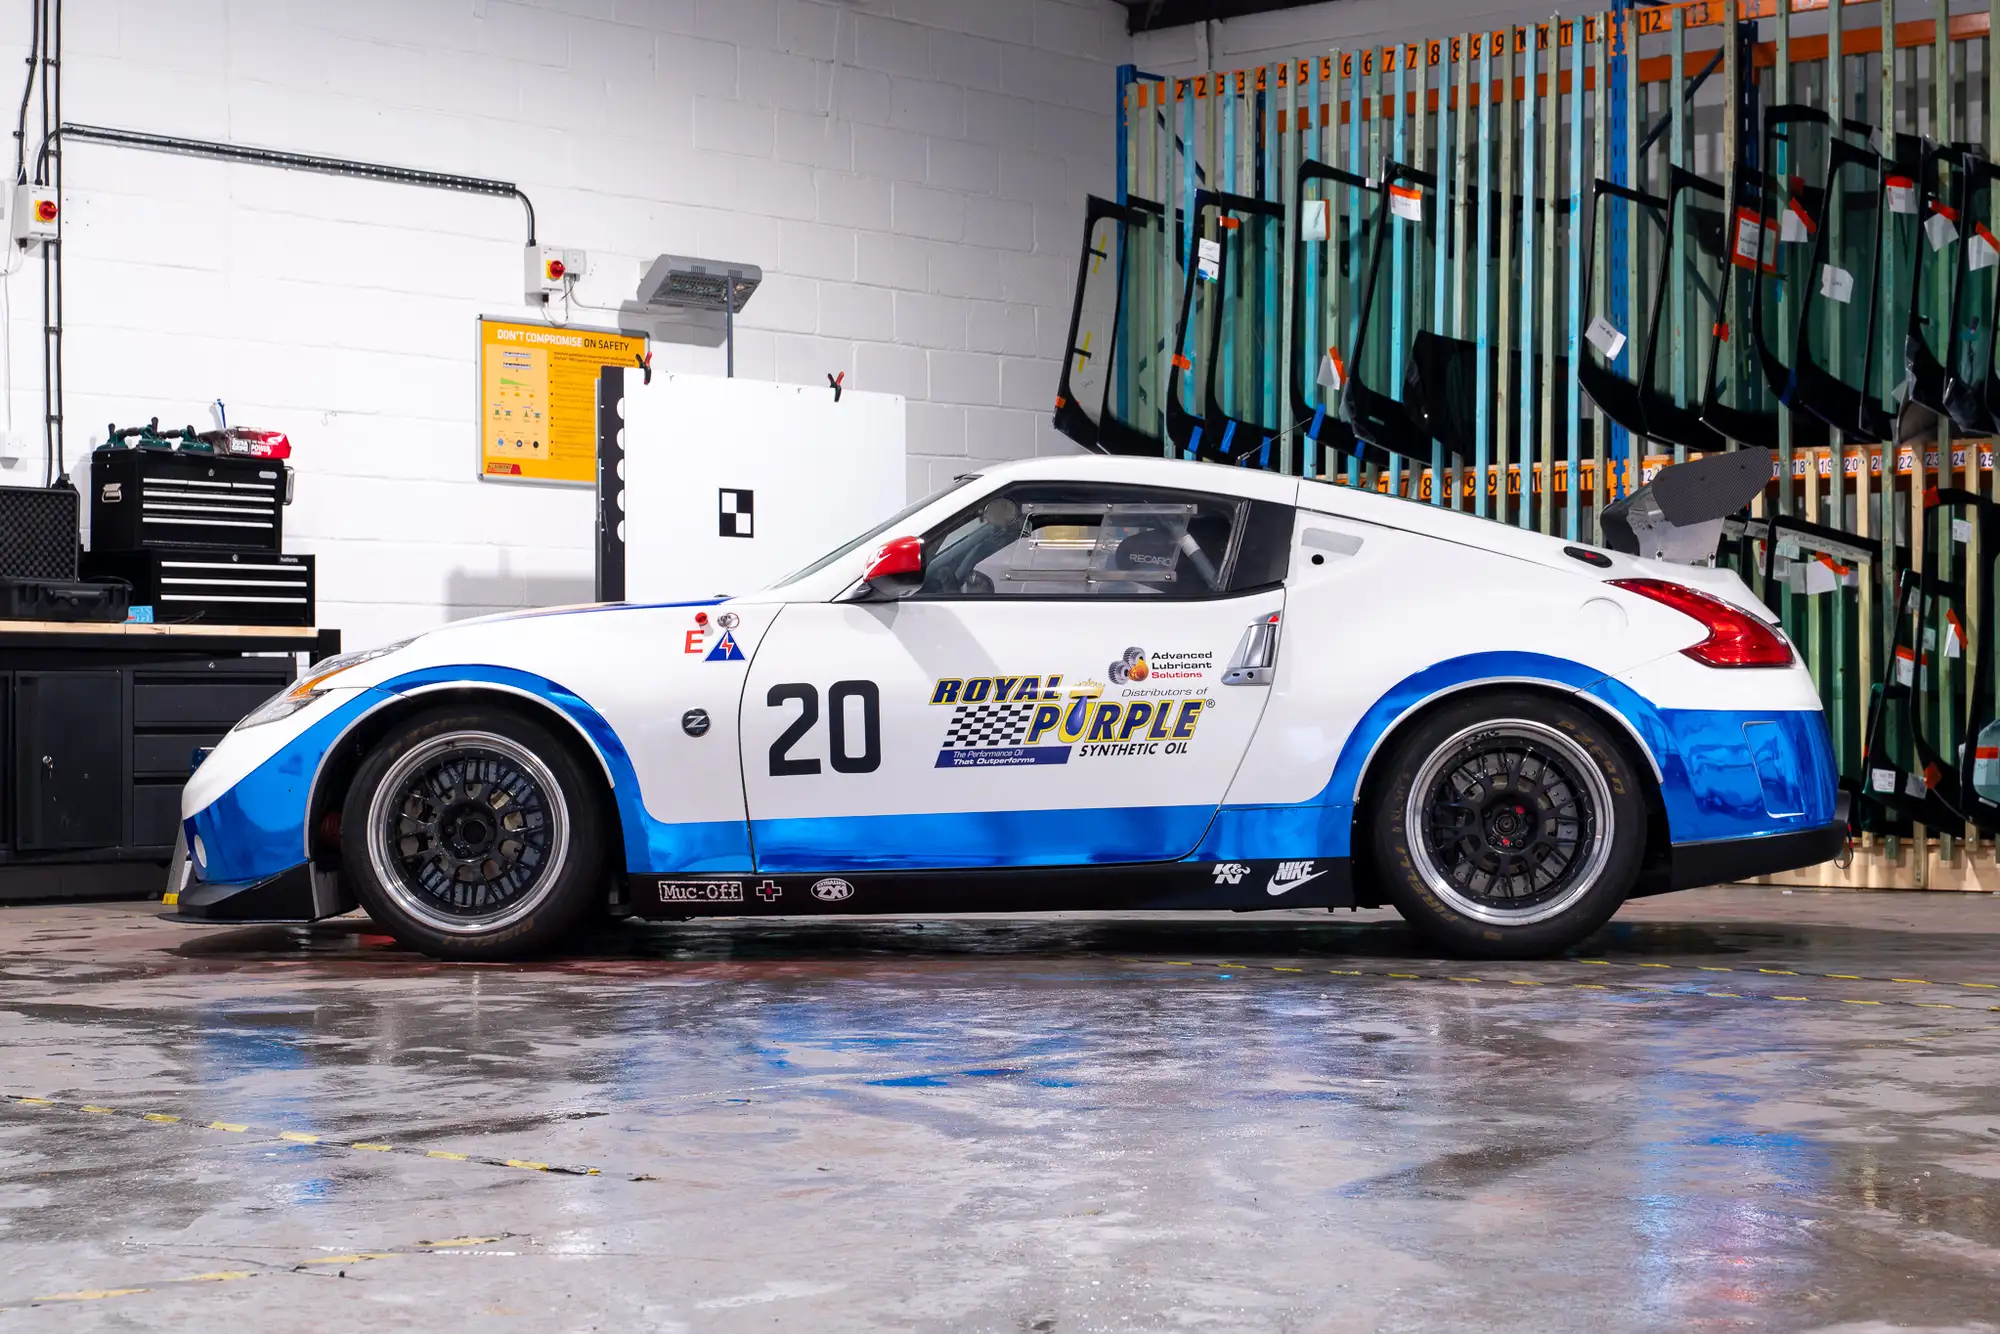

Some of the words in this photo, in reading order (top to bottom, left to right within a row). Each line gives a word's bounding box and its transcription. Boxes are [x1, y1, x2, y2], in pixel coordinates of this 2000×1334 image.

[1198, 78, 1206, 97] 2
[1218, 74, 1225, 94] 3
[1257, 68, 1266, 88] 4
[1278, 65, 1287, 86] 4
[1300, 63, 1309, 84] 5
[1323, 58, 1330, 79] 5
[1343, 56, 1351, 76] 6
[1364, 53, 1372, 73] 6
[1385, 51, 1395, 72] 7
[1407, 48, 1417, 69] 7
[1431, 43, 1440, 65] 8
[1495, 34, 1503, 56] 9
[1642, 10, 1662, 31] 12
[1690, 2, 1708, 24] 13
[497, 329, 524, 341] DON'T
[526, 332, 582, 348] COMPROMISE
[583, 338, 596, 349] ON
[598, 339, 629, 352] SAFETY
[1423, 477, 1431, 497] 8
[1467, 475, 1476, 496] 9
[1488, 473, 1497, 493] 9
[1792, 460, 1805, 473] 18
[1820, 459, 1832, 472] 19
[1844, 458, 1857, 471] 20
[1899, 455, 1912, 470] 22
[1926, 453, 1939, 466] 23
[1953, 452, 1966, 466] 24
[1981, 453, 1993, 467] 25
[1129, 553, 1173, 567] RECARO
[684, 630, 705, 654] E
[1151, 651, 1212, 660] Advanced
[1152, 661, 1212, 670] Lubricant
[1152, 671, 1203, 679] Solutions
[929, 674, 1064, 705] ROYAL
[1121, 688, 1192, 698] Distributors
[1195, 686, 1209, 696] of
[766, 679, 882, 777] 20
[953, 750, 966, 758] The
[967, 749, 1013, 759] Performance
[1014, 748, 1024, 757] Oil
[1079, 742, 1158, 757] SYNTHETIC
[1164, 741, 1188, 755] OIL
[976, 757, 1036, 766] Outperforms
[1274, 860, 1315, 880] NIKE
[662, 884, 740, 900] Muc-Off
[816, 884, 849, 900] ZX1
[1396, 846, 1459, 923] PIRELLI
